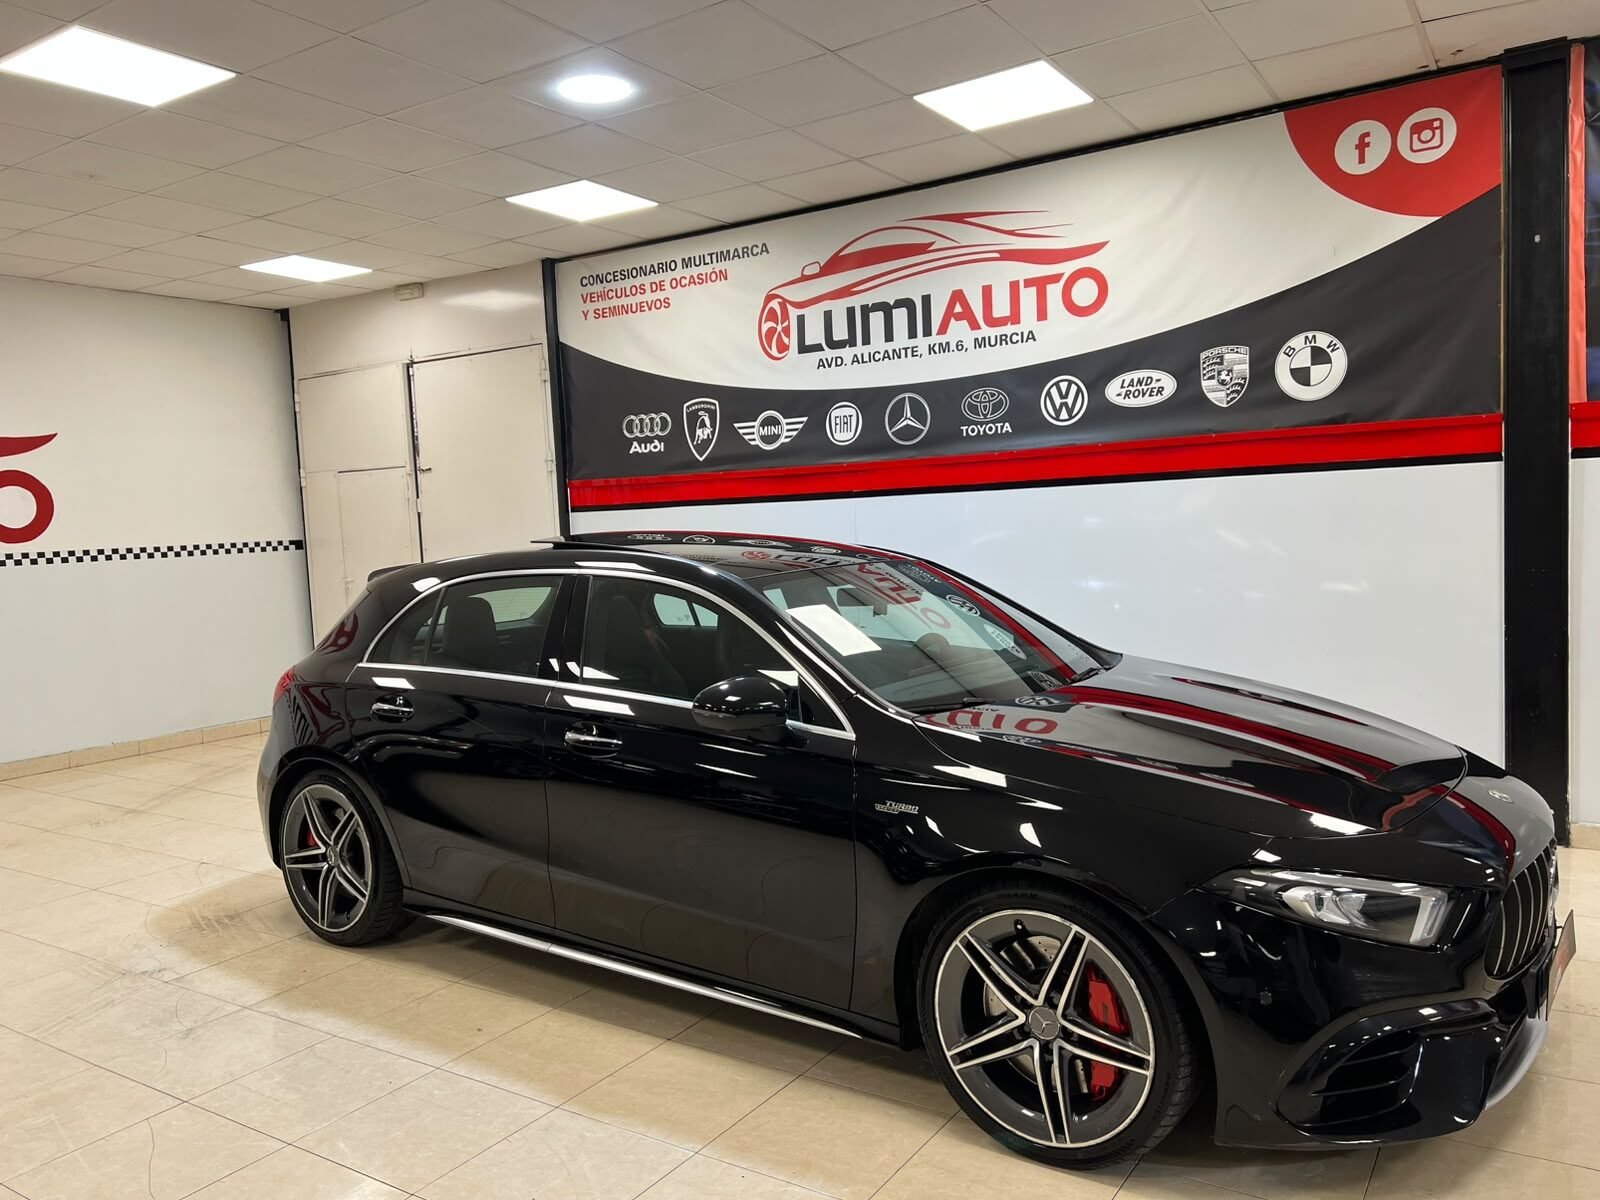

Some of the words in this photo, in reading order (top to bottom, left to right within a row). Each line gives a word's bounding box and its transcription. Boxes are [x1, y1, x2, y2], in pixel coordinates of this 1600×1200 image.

[580, 260, 677, 287] CONCESIONARIO
[681, 243, 770, 269] MULTIMARCA
[581, 283, 646, 304] VEHÍCULOS
[650, 280, 665, 293] DE
[670, 267, 728, 289] OCASIÓN
[582, 310, 589, 321] Y
[593, 297, 671, 320] SEMINUEVOS
[816, 356, 847, 369] AVD.
[850, 347, 923, 366] ALICANTE,
[973, 330, 1037, 349] MURCIA
[1202, 346, 1247, 359] PORSCHE
[1283, 334, 1341, 358] BMW
[686, 403, 716, 413] LAMBORGHINI
[759, 424, 782, 436] MINI
[834, 414, 854, 434] FIAT
[960, 422, 1012, 436] TOYOTA
[629, 439, 664, 454] Audi
[885, 800, 919, 812] TURBO
